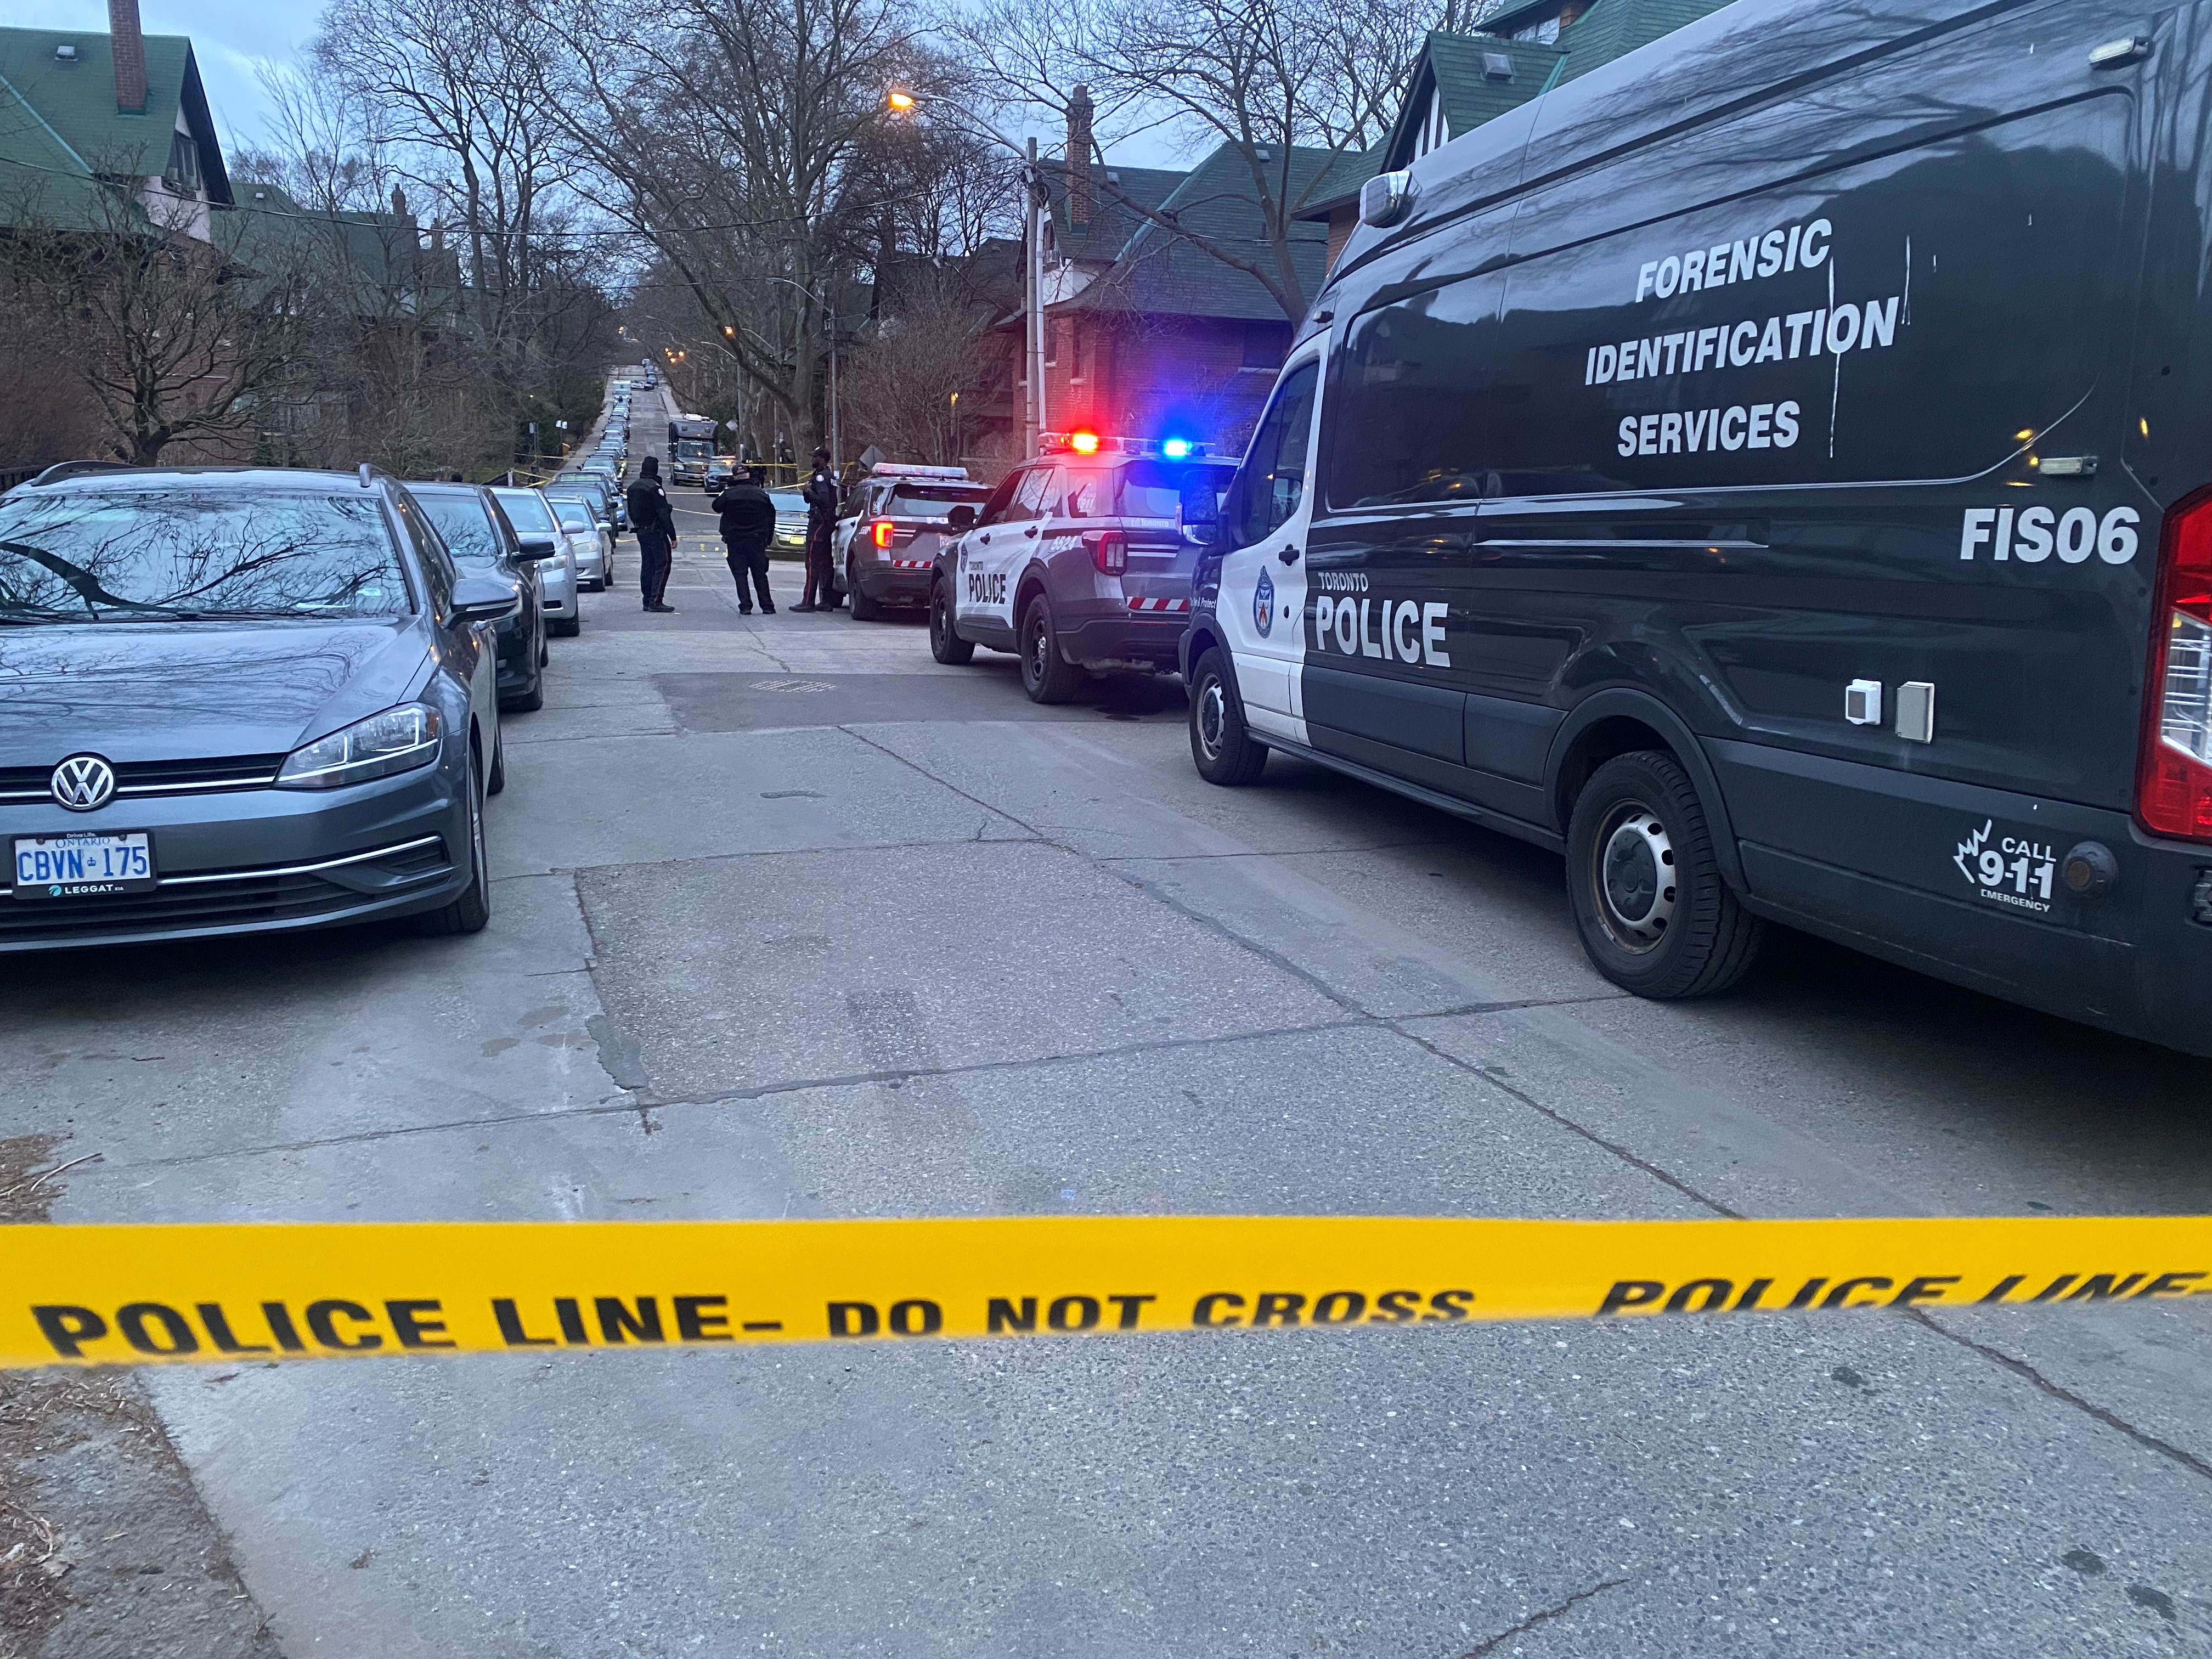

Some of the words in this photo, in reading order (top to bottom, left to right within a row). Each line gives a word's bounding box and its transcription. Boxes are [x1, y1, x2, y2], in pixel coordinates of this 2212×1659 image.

[1635, 218, 1833, 303] FORENSIC
[1585, 296, 1900, 386] IDENTIFICATION
[1617, 400, 1801, 457] SERVICES
[1141, 518, 1169, 528] TORONTO
[1960, 506, 2140, 565] FIS06
[1051, 535, 1078, 550] 5524
[969, 574, 1006, 605] POLICE
[1318, 572, 1369, 592] TORONTO
[1316, 595, 1451, 668] POLICE
[55, 837, 110, 848] ONTARIO
[2002, 837, 2057, 862] CALL
[18, 849, 84, 881] CBVN
[104, 846, 147, 877] 175
[1978, 850, 2054, 899] 9-1-1
[65, 884, 114, 894] LEGGAT
[1981, 888, 2050, 912] EMERGENCY
[30, 1298, 458, 1359] POLICE
[827, 1299, 943, 1339] DO
[987, 1294, 1158, 1333] NOT
[1192, 1289, 1476, 1328] CROSS
[1593, 1274, 1962, 1318] POLICE
